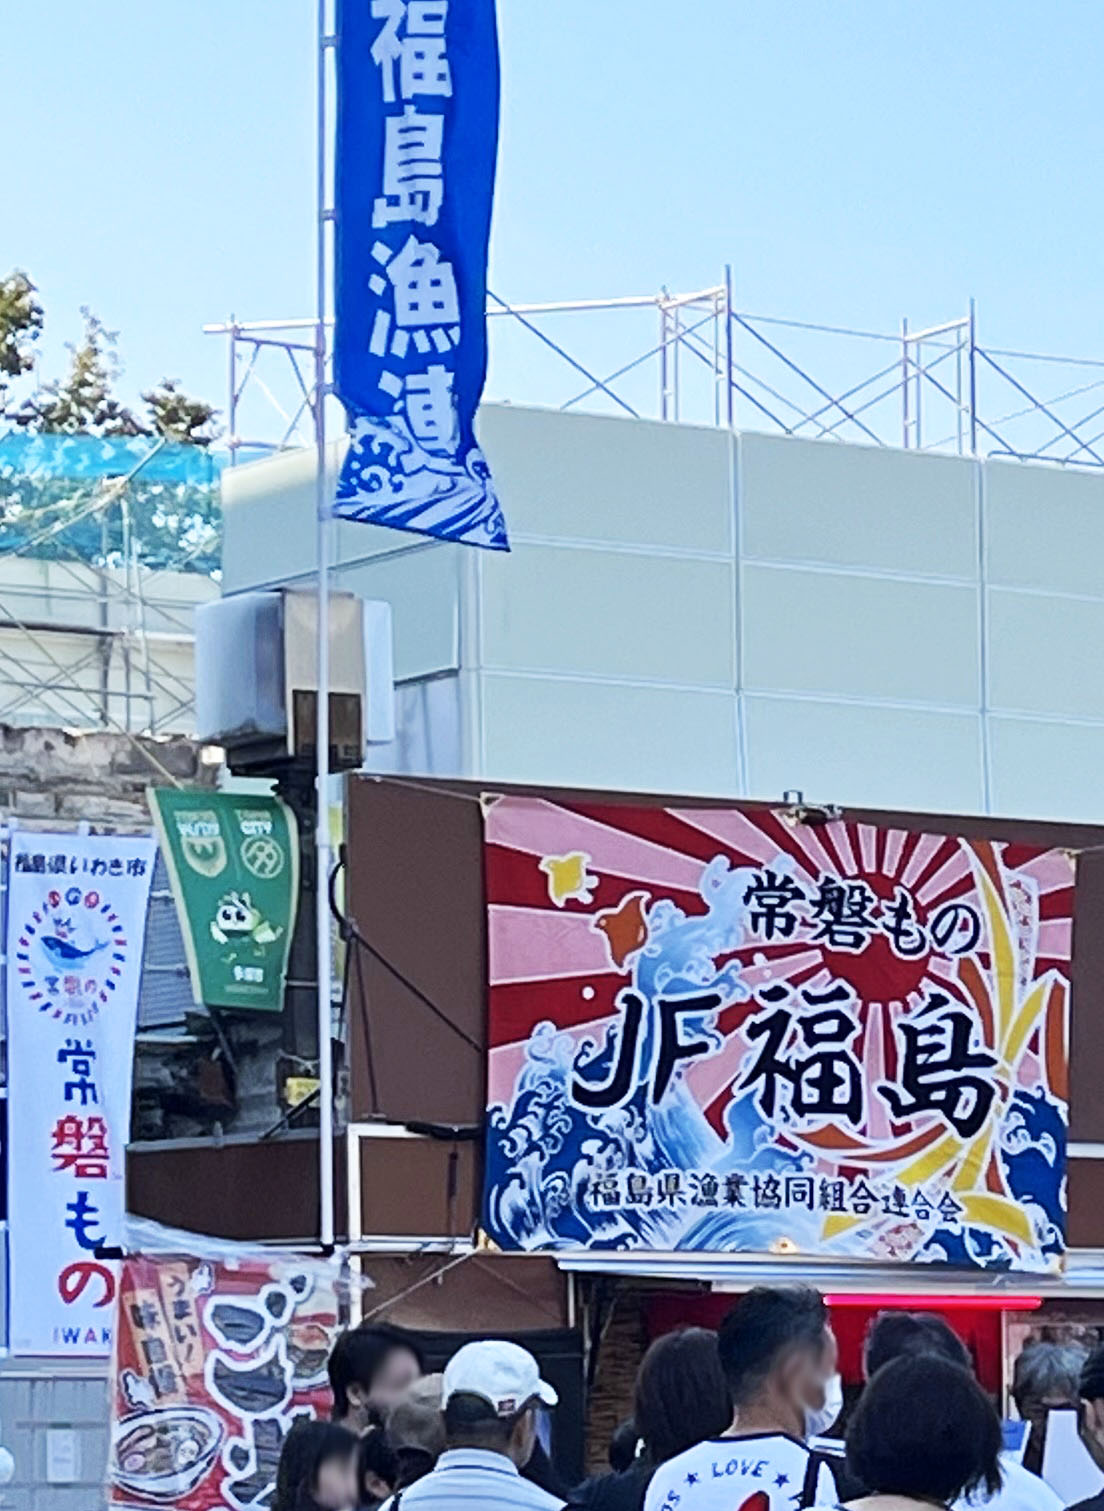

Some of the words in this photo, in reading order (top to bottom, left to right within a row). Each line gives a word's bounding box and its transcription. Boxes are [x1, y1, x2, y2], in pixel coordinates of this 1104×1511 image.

[743, 869, 981, 956] 常磐もの
[49, 1037, 116, 1309] 常磐もの
[588, 1171, 966, 1225] 福島県漁業協同組合連合会
[53, 1327, 112, 1344] IWAK
[711, 1459, 770, 1478] LOVE
